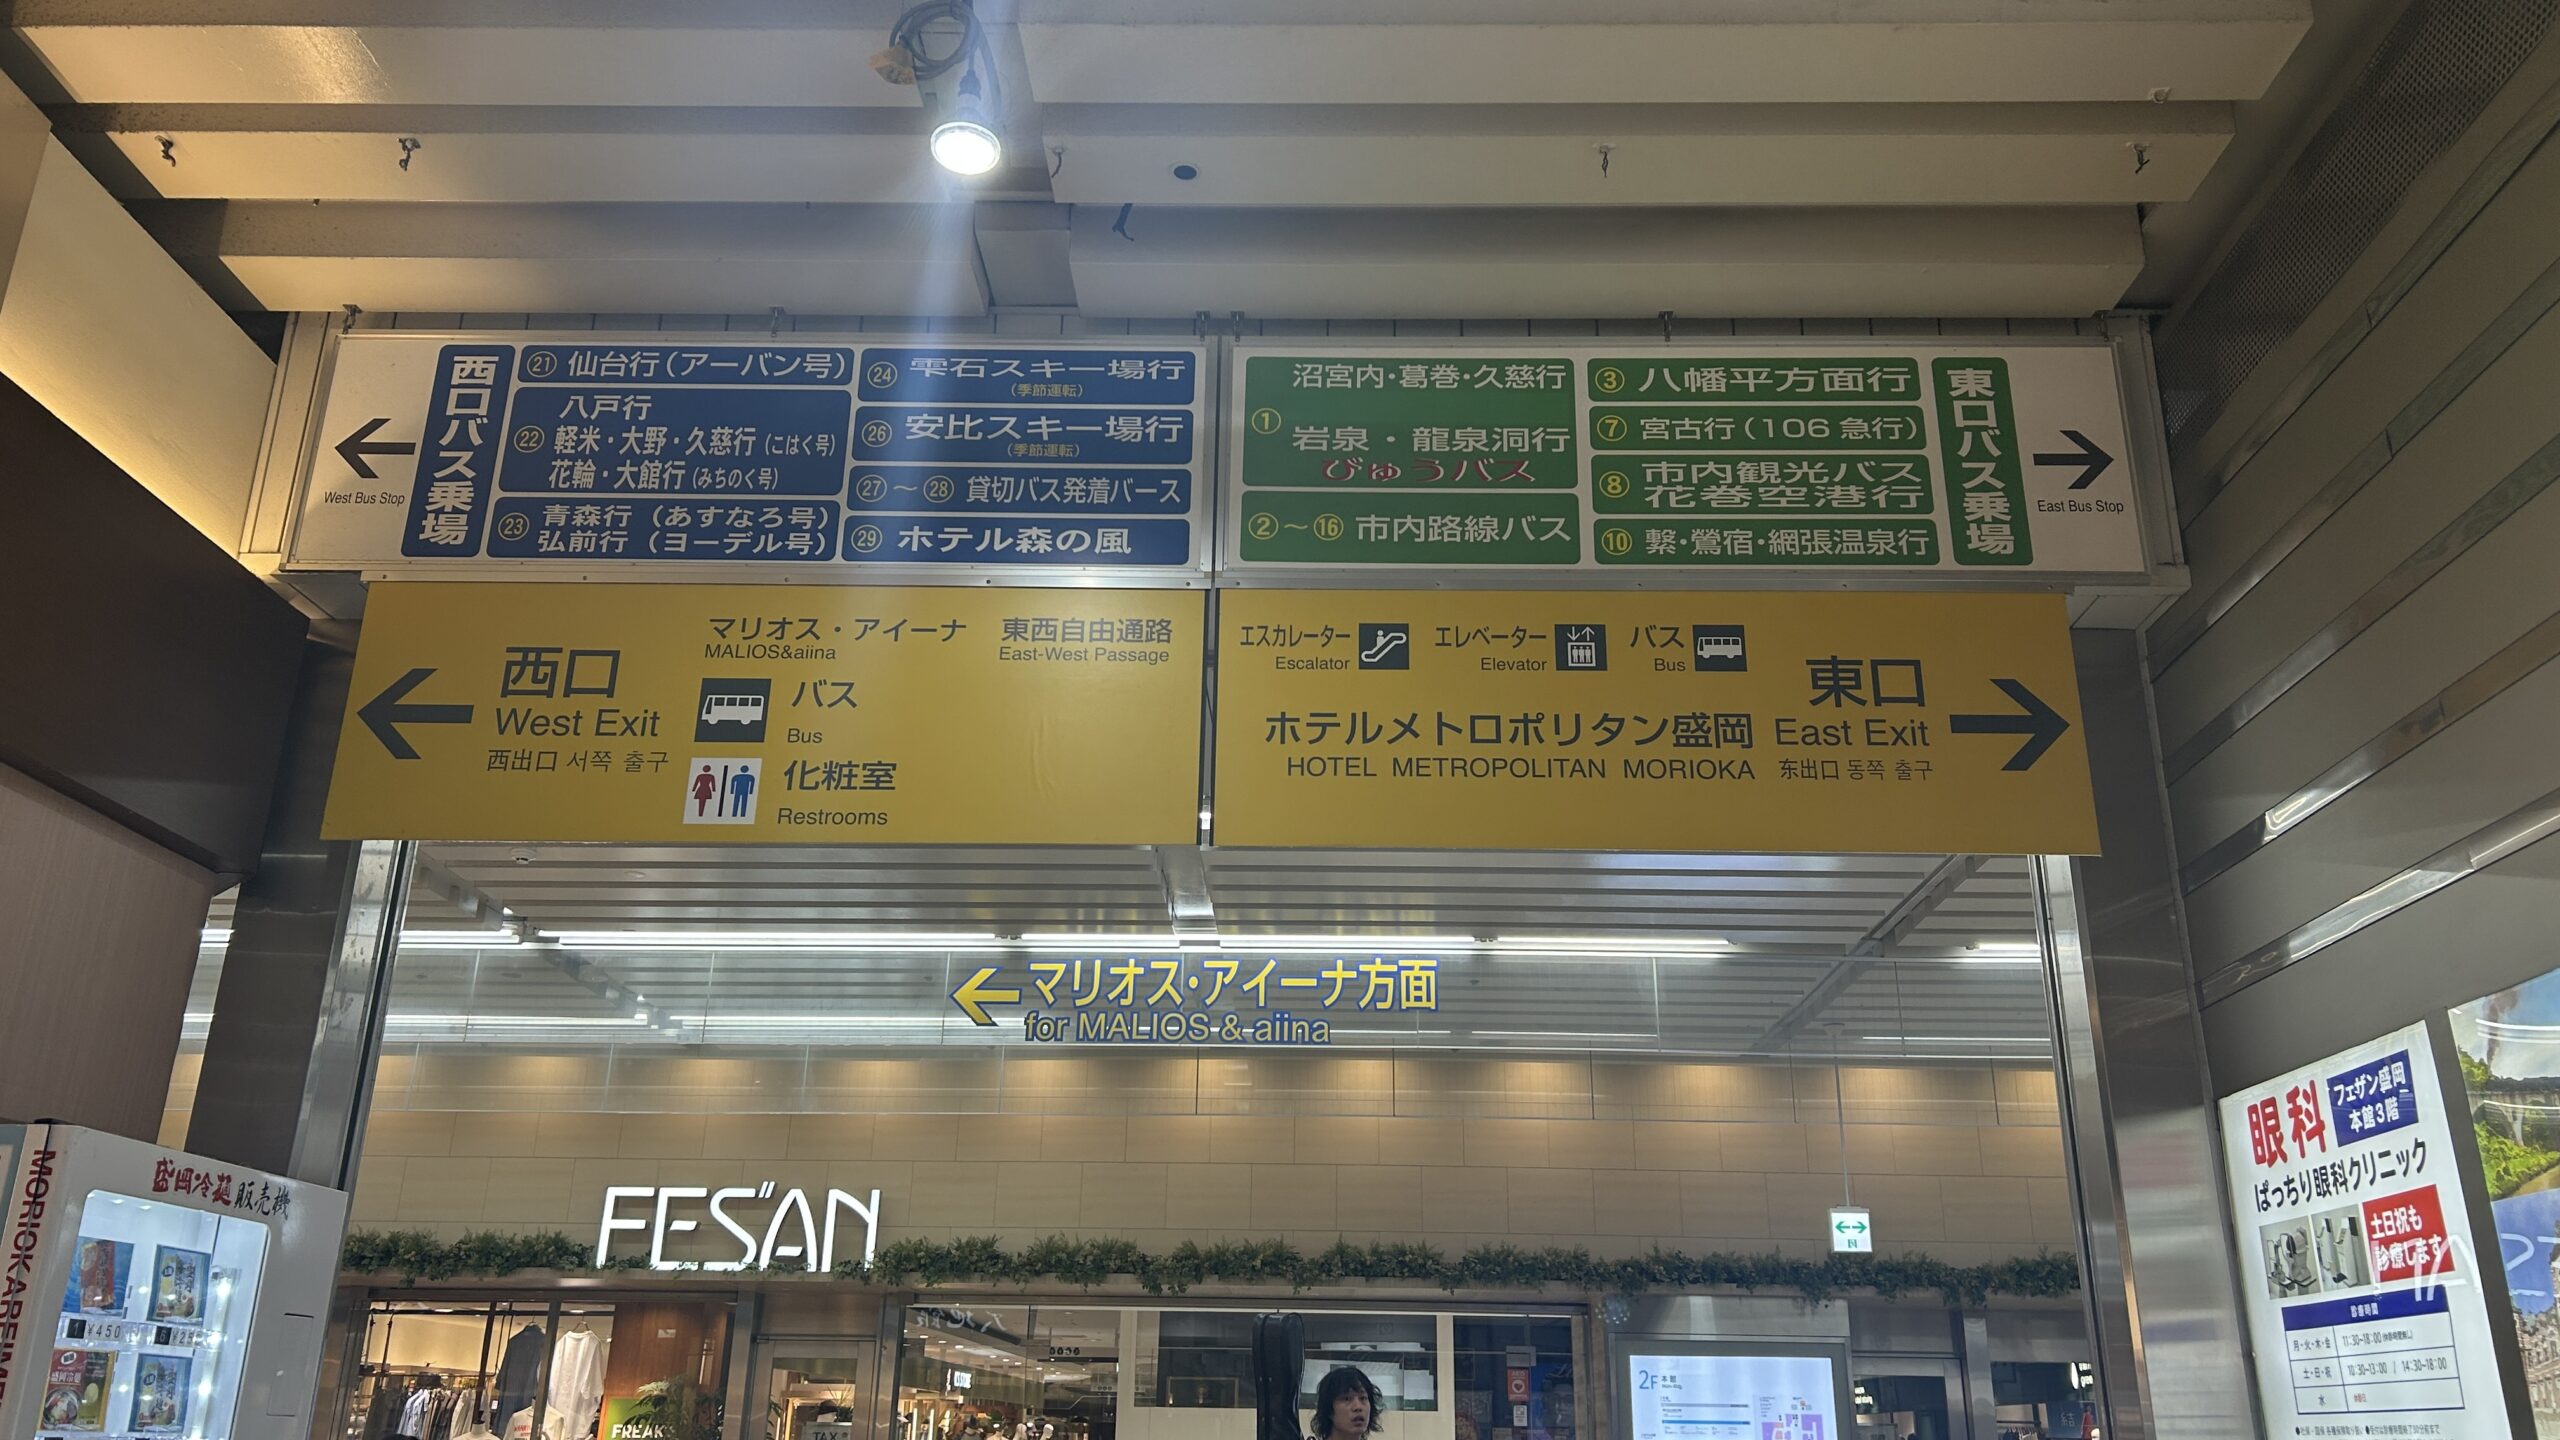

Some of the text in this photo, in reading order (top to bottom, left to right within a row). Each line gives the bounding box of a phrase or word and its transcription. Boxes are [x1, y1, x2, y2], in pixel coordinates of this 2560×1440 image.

[909, 357, 1186, 381] 雫石スキー場行
[1638, 366, 1912, 394] 八幡平方面行
[559, 395, 652, 421] 八戸行
[904, 413, 1184, 443] 安比スキー場行
[420, 355, 500, 545] 西口バス乗場
[1947, 367, 2016, 556] 東口バス乗場
[548, 459, 687, 490] 花輪・大館行
[1321, 457, 1536, 482] びゅうバス
[1641, 462, 1923, 485] 市内観光バス
[323, 490, 405, 507] West Bus Stop
[966, 476, 1182, 503] 貸切バス発着バース
[1643, 485, 1925, 509] 花巻空港行
[543, 505, 633, 527] 青森行
[2037, 500, 2124, 517] East Bus Stop
[898, 526, 1132, 555] ホテル森の風
[1356, 515, 1572, 542] 市内路線バス
[537, 530, 629, 555] 弘前行
[1001, 617, 1174, 645] 東西自由通路
[1240, 623, 1351, 648] エスカレーター
[1435, 624, 1547, 650] エレベーター
[1629, 624, 1686, 650] バス
[704, 644, 836, 661] MALIOS&aiina
[1000, 646, 1170, 666] East-West Passage
[1275, 656, 1350, 672] Escalator
[1481, 657, 1547, 673] Elevator
[1654, 658, 1687, 673] Bus
[500, 646, 621, 698] 西口
[1805, 655, 1926, 708] 東口
[791, 679, 859, 709] バス
[495, 707, 661, 738] West Exit
[1265, 711, 1754, 750] ホテルメトロポリタン盛岡
[1775, 718, 1930, 747] East Exit
[787, 728, 823, 745] Bus
[487, 749, 559, 772] 西出口
[566, 750, 669, 775] 서쪽 출구
[1286, 756, 1756, 780] HOTEL METROPOLITAN MORIOKA
[1779, 757, 1839, 781] 东出口
[1846, 758, 1934, 781] 동쪽 출구
[783, 759, 898, 793] 化粧室
[777, 808, 889, 826] Restrooms
[1028, 957, 1440, 1011] マリオス・アイーナ方面
[1024, 1012, 1332, 1044] for MALIOS & aiina
[2333, 1061, 2407, 1106] フェザン盛岡
[2246, 1079, 2328, 1169] 眼科
[2349, 1096, 2400, 1134] 本館3階
[2, 1149, 56, 1298] MORIOKA
[2370, 1204, 2424, 1240] 土日祝も
[2375, 1234, 2444, 1272] 診療します
